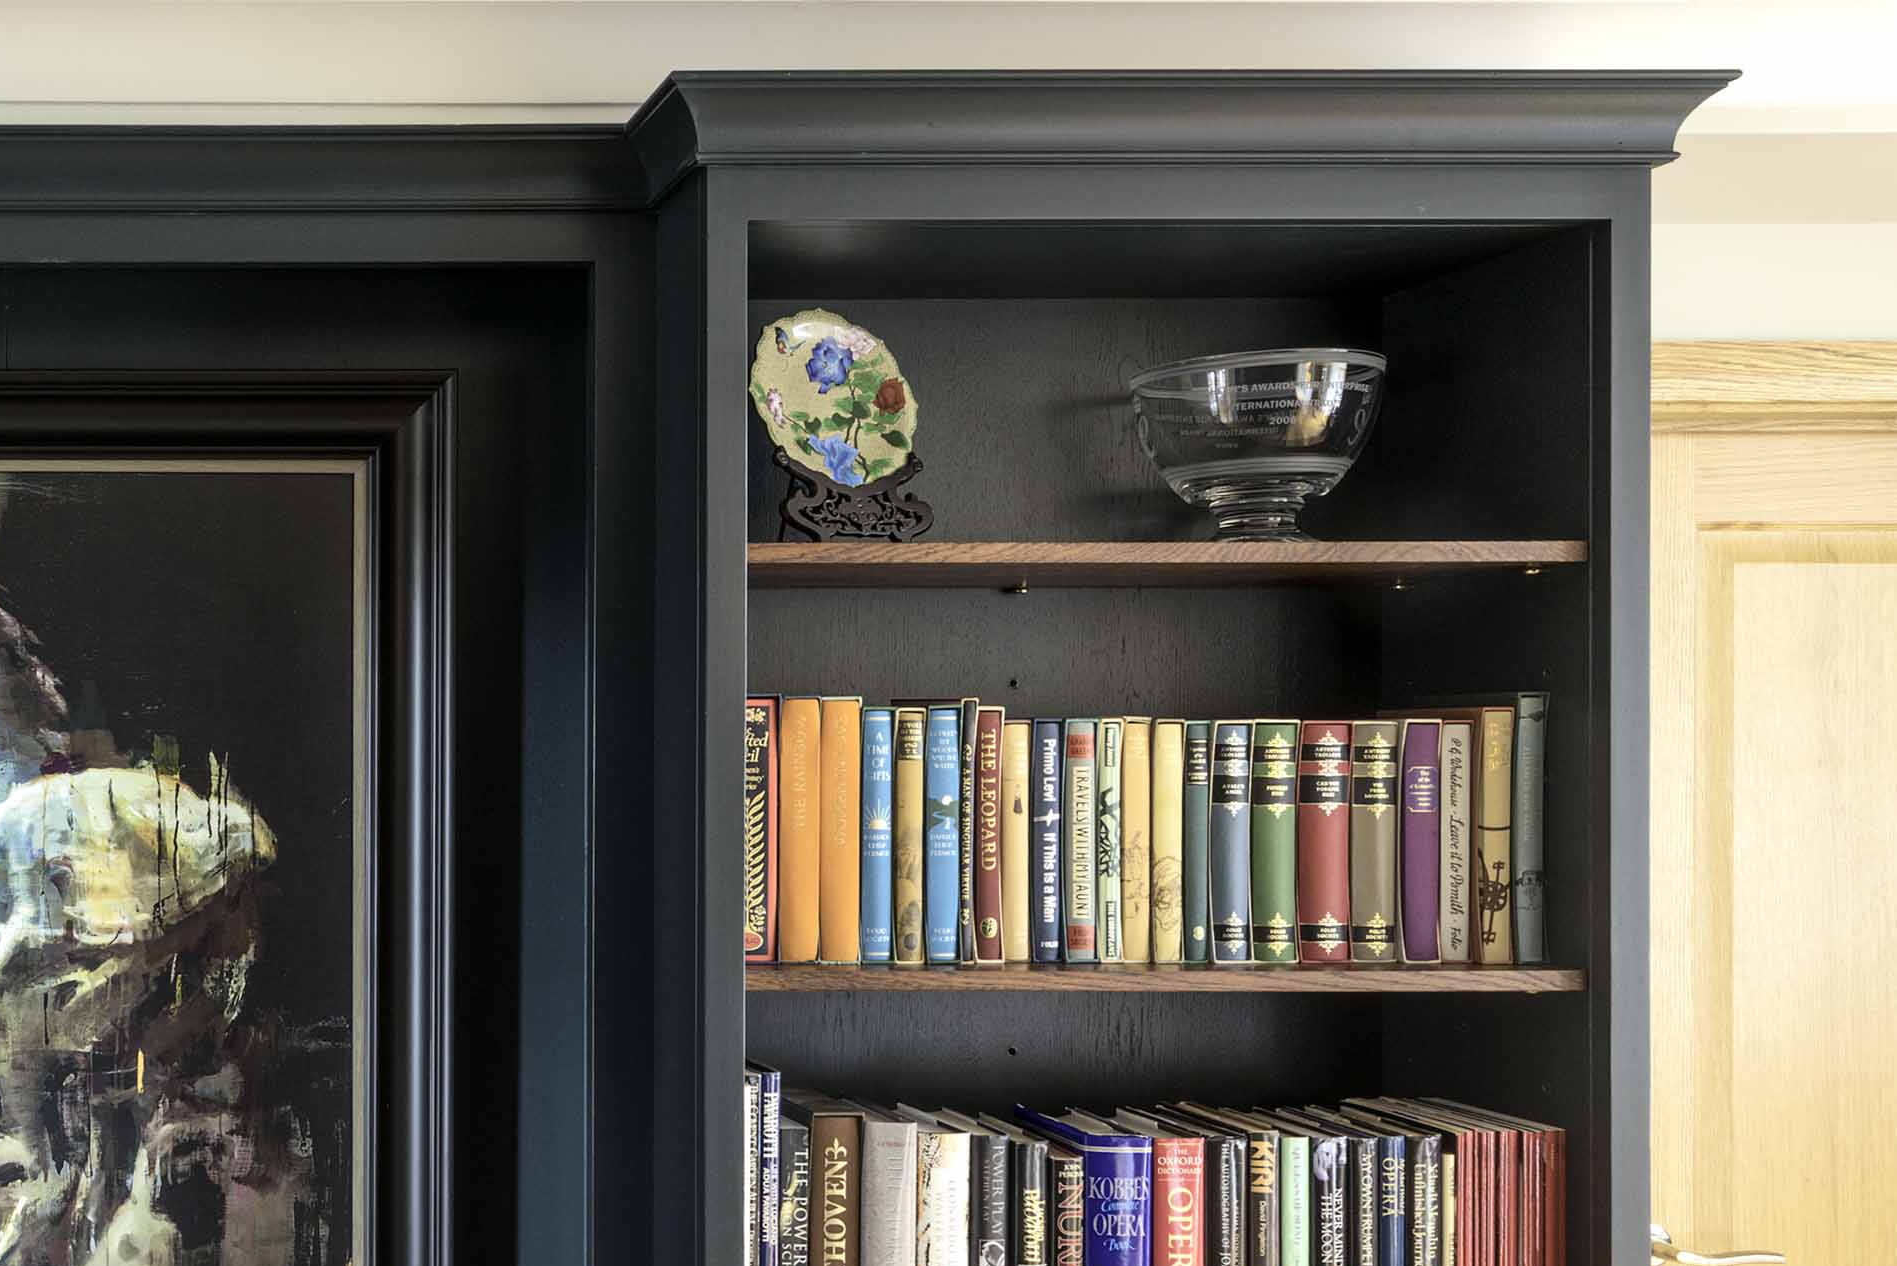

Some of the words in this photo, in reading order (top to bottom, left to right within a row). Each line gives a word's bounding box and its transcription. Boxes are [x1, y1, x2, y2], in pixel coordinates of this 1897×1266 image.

[981, 729, 996, 771] THE
[1043, 738, 1056, 775] Primo
[1043, 777, 1057, 801] Levi
[981, 777, 997, 871] LEOPARD
[794, 1150, 808, 1187] THE
[1158, 1156, 1202, 1166] OXFORD
[1251, 1141, 1274, 1193] KIRI
[1093, 1213, 1146, 1237] OPERA
[1321, 1193, 1333, 1220] THE
[1333, 1188, 1343, 1230] NEVER
[793, 1196, 808, 1264] POWER
[1322, 1223, 1333, 1264] MOON
